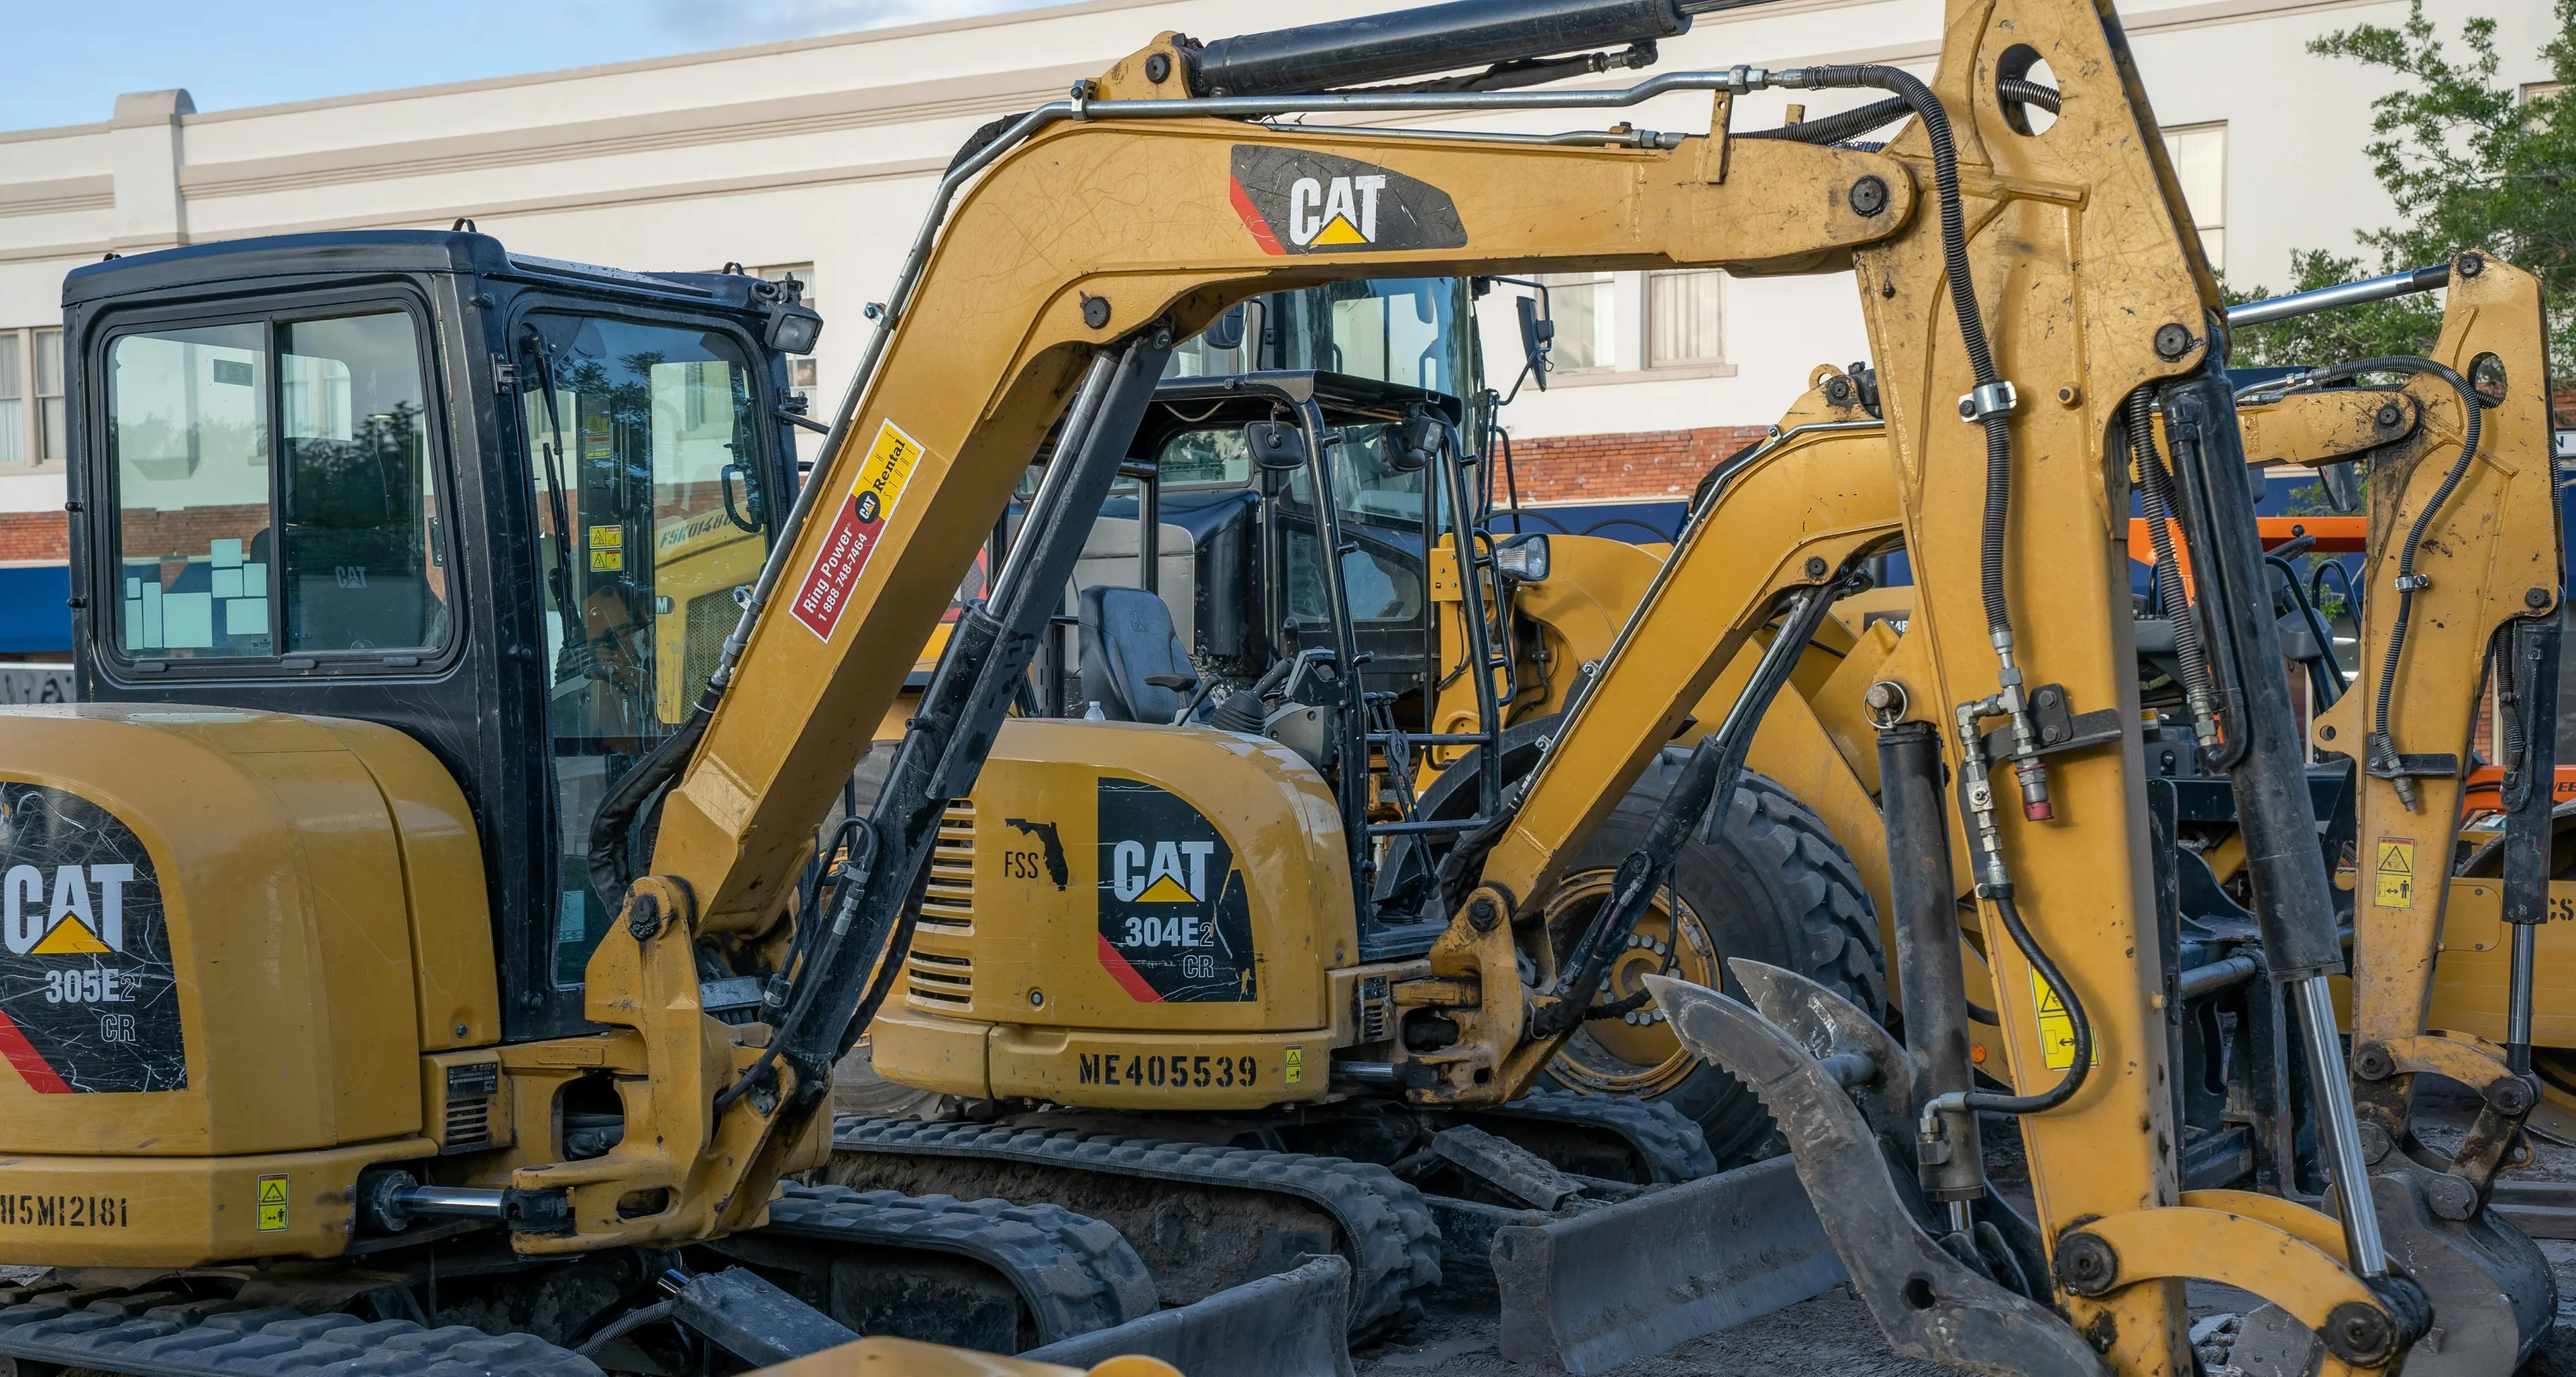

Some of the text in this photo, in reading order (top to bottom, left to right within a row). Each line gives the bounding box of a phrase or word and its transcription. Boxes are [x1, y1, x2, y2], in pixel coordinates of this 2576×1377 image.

[1290, 174, 1385, 245] CAT
[863, 431, 896, 485] THE
[873, 439, 906, 494] Rental
[883, 447, 915, 500] STORE
[859, 495, 876, 520] CAT
[335, 565, 367, 588] CAT
[802, 578, 830, 614] Ring
[818, 612, 827, 622] 1
[1004, 851, 1038, 879] FSS
[1114, 840, 1214, 902] CAT
[4, 864, 133, 955] CAT
[1125, 916, 1214, 946] 304E2
[1183, 955, 1214, 978] CR
[45, 969, 135, 1003] 305E2
[101, 1014, 136, 1042] CR
[1079, 1053, 1256, 1087] ME405539
